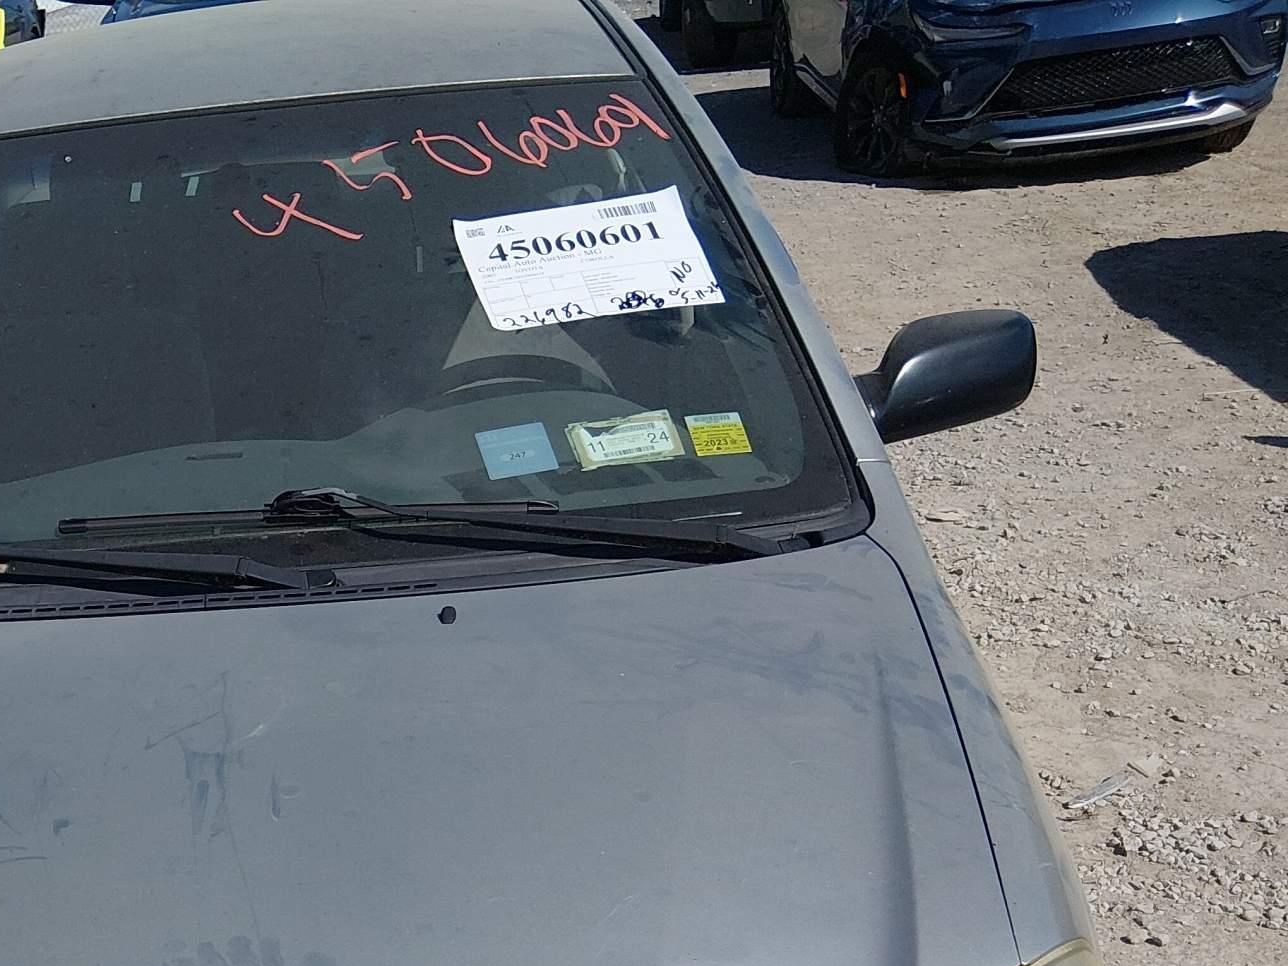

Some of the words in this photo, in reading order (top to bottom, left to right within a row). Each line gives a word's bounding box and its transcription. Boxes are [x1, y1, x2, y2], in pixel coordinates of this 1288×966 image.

[488, 221, 664, 262] 45060601
[478, 262, 511, 274] Capital
[514, 258, 537, 268] Auto
[538, 252, 576, 264] Auction
[584, 248, 603, 257] MG
[588, 440, 607, 453] 11
[647, 431, 671, 445] 24
[703, 438, 729, 448] 2023
[509, 450, 527, 461] 247
